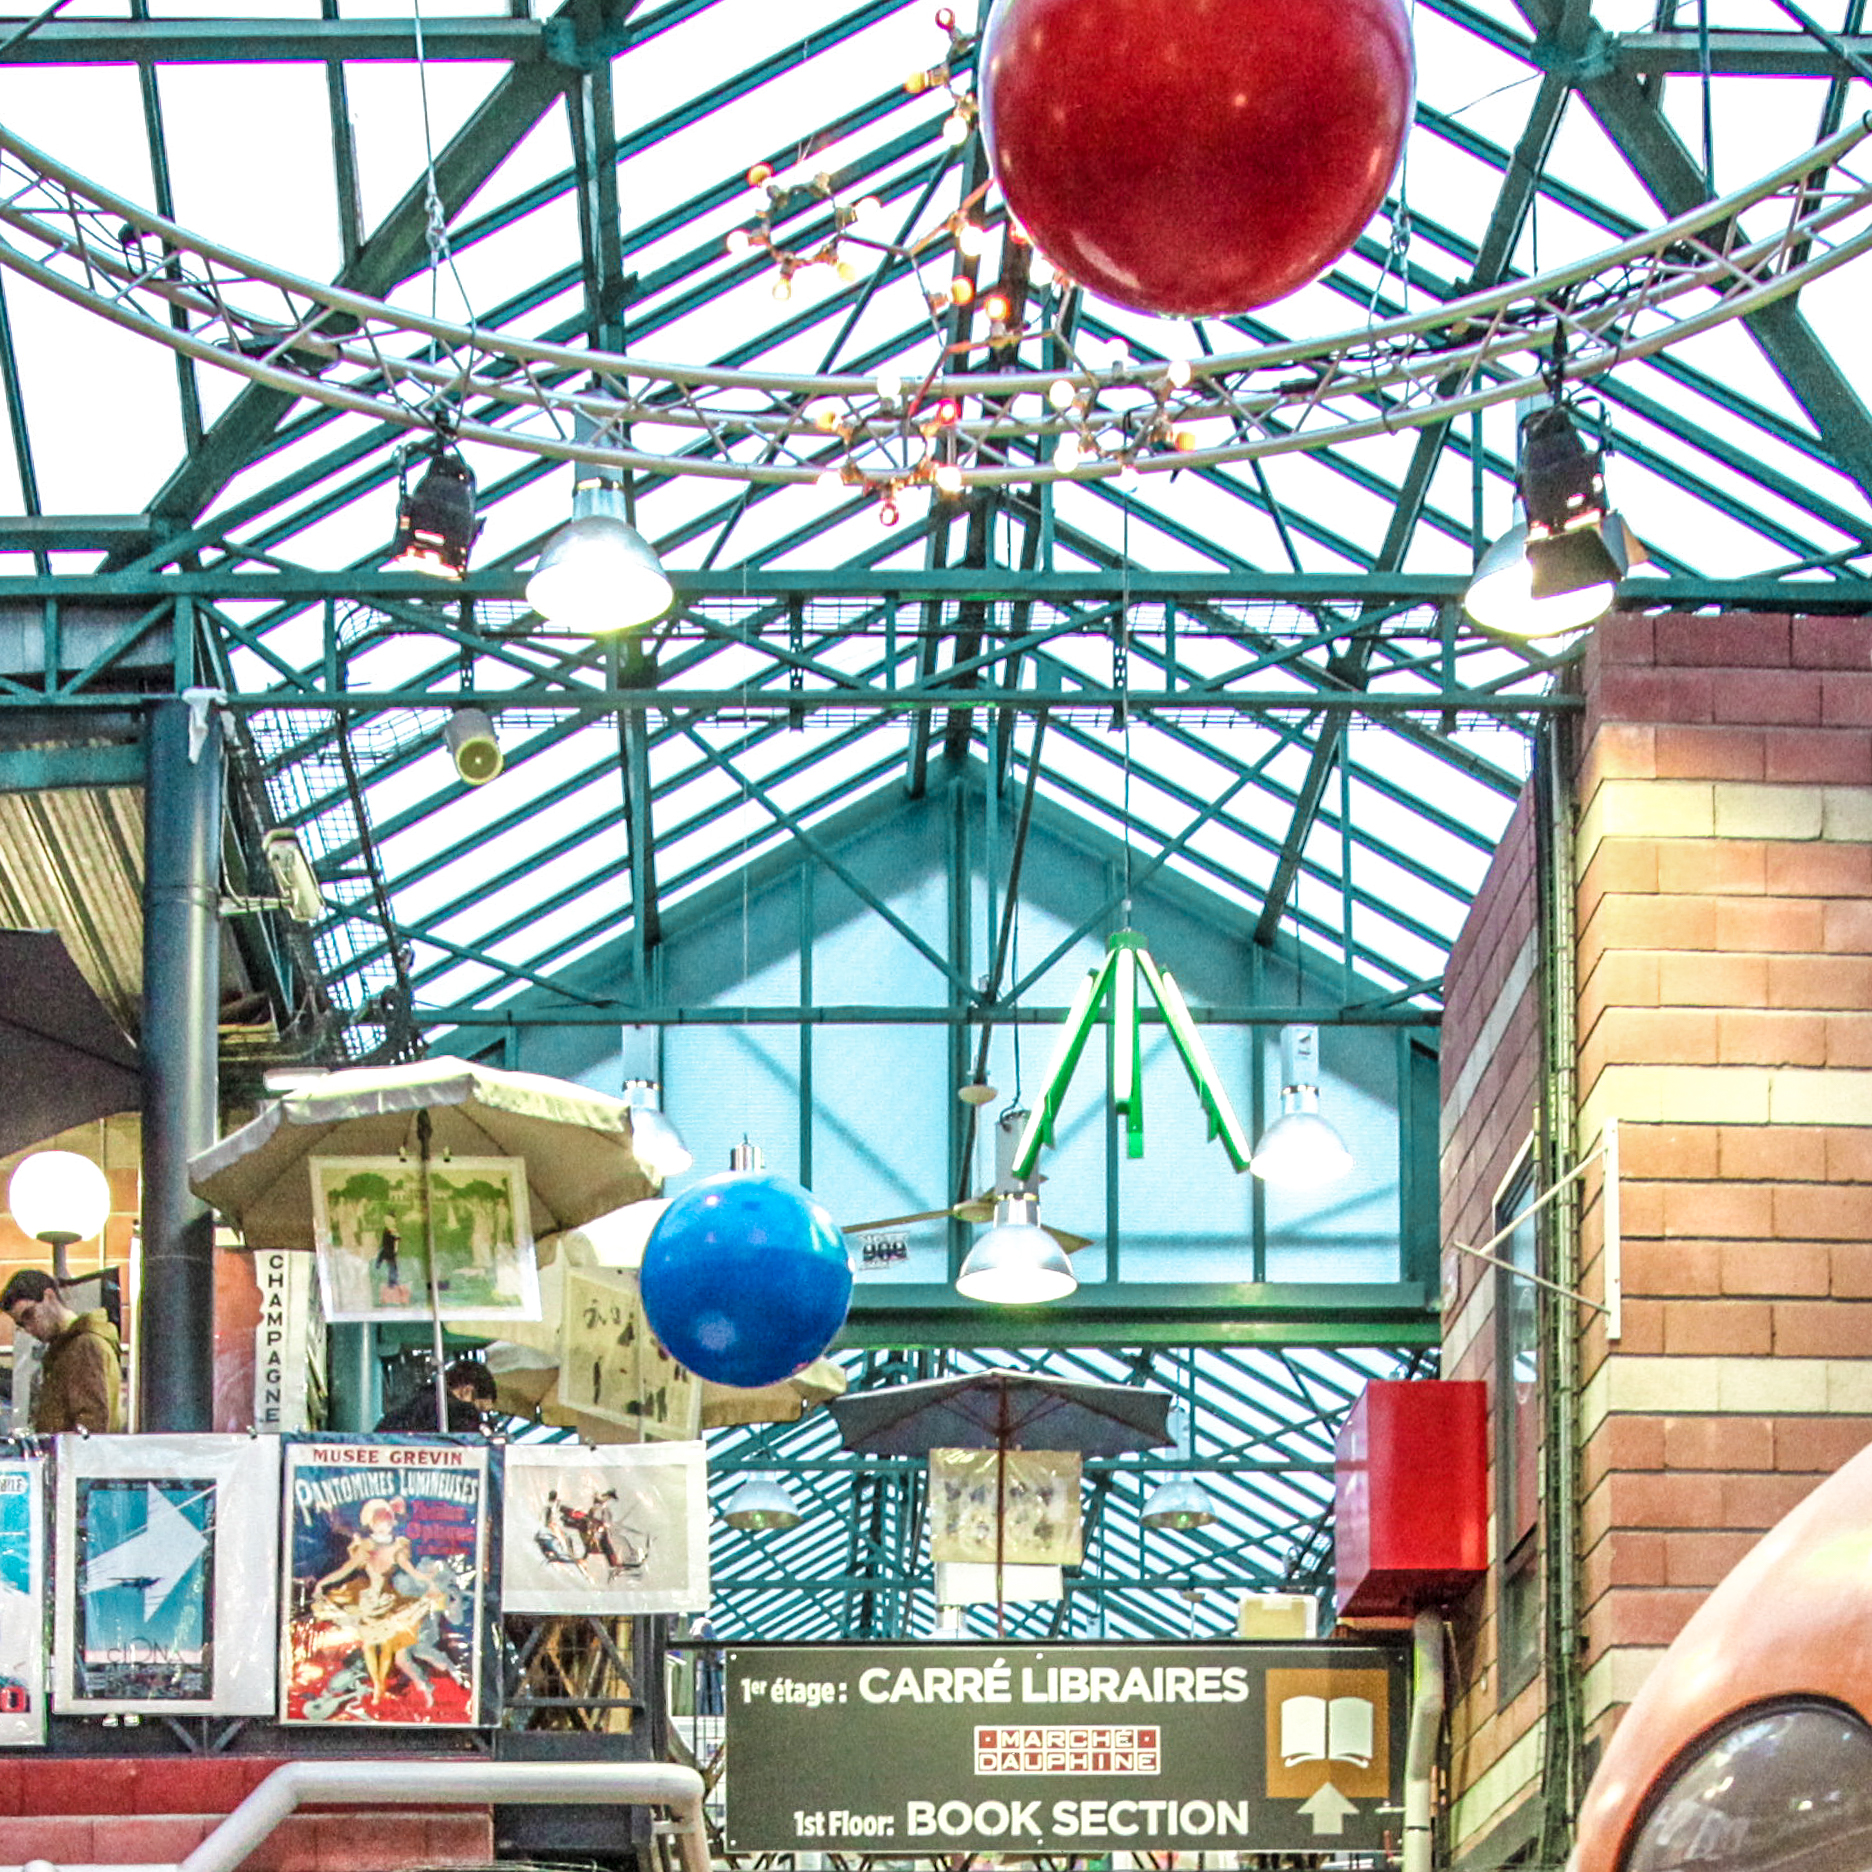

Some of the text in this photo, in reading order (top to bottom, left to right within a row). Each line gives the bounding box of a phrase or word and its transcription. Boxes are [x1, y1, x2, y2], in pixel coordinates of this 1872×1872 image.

[264, 1254, 285, 1424] CHAMPAGNE
[294, 1470, 395, 1527] PANTOMIMES
[399, 1469, 479, 1506] LUMINEUSES
[740, 1677, 767, 1704] 1er
[858, 1657, 1013, 1704] CARRÉ
[1021, 1666, 1250, 1703] LIBRAIRES
[1001, 1728, 1134, 1748] MARCHÉ
[978, 1752, 1157, 1771] DAUPHINE
[793, 1800, 1250, 1837] 1st Floor: BOOK SECTION
